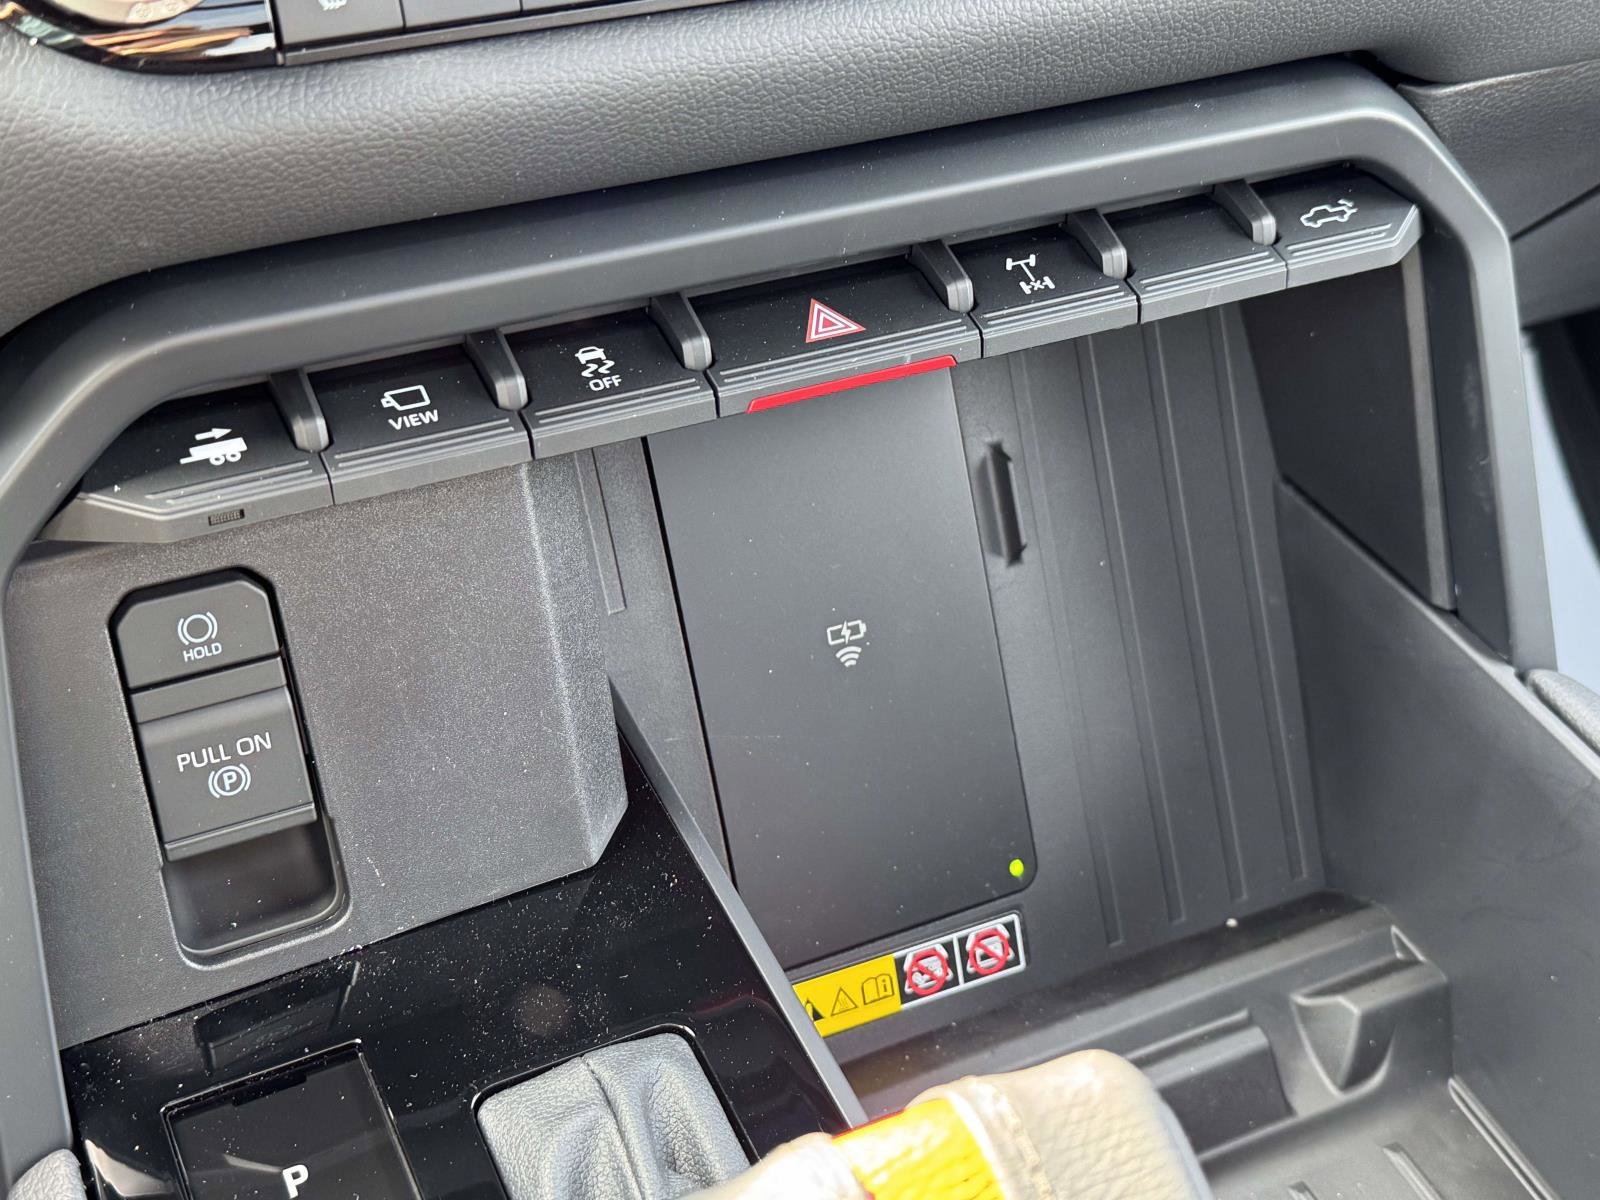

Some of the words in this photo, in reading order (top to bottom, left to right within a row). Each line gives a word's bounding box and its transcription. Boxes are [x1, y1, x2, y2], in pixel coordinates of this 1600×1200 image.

[589, 375, 622, 391] OFF
[388, 409, 439, 430] VIEW
[183, 642, 222, 662] HOLD
[176, 744, 231, 772] PULL
[236, 732, 272, 756] ON
[222, 771, 237, 791] P
[282, 1164, 309, 1199] P
